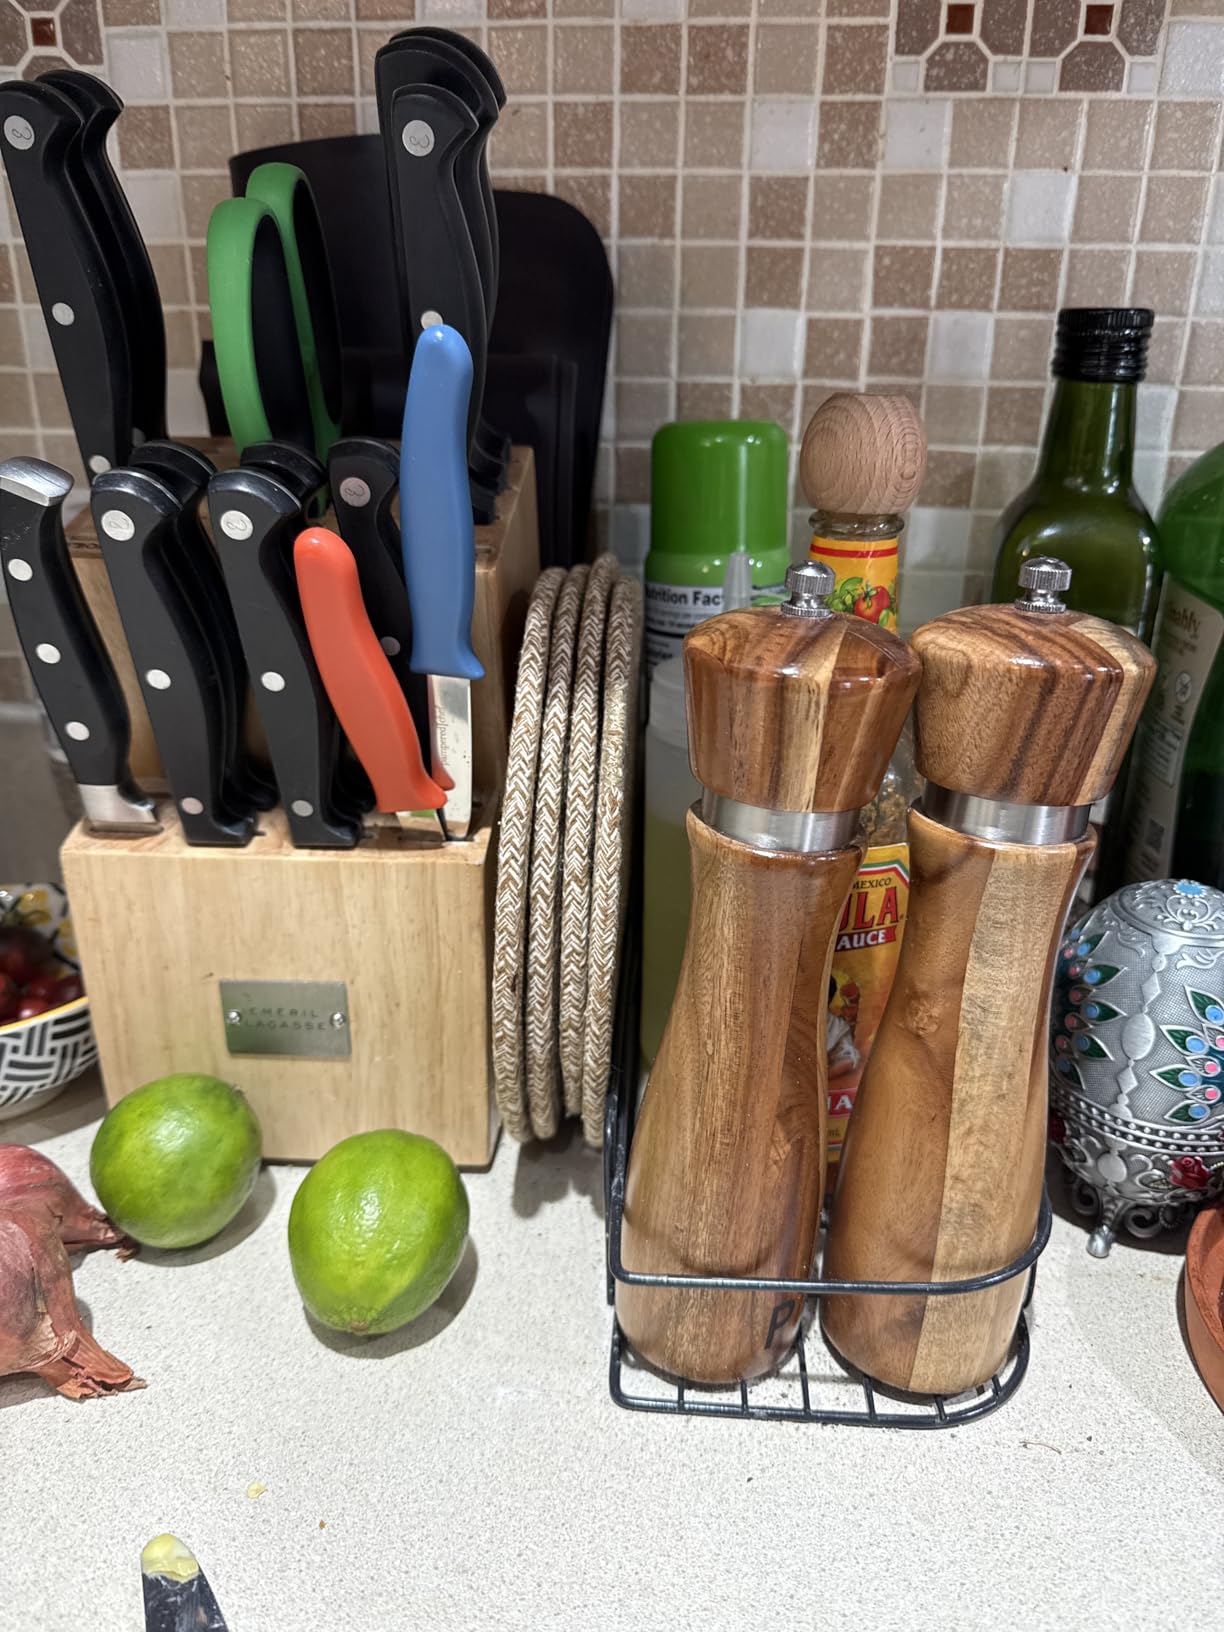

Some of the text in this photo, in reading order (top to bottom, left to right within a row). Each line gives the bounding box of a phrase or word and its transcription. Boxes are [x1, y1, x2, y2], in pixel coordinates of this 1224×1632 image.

[693, 591, 724, 606] Fac
[248, 1007, 320, 1018] EMERIL
[244, 1020, 327, 1031] LAGASSE
[766, 1300, 795, 1349] P
